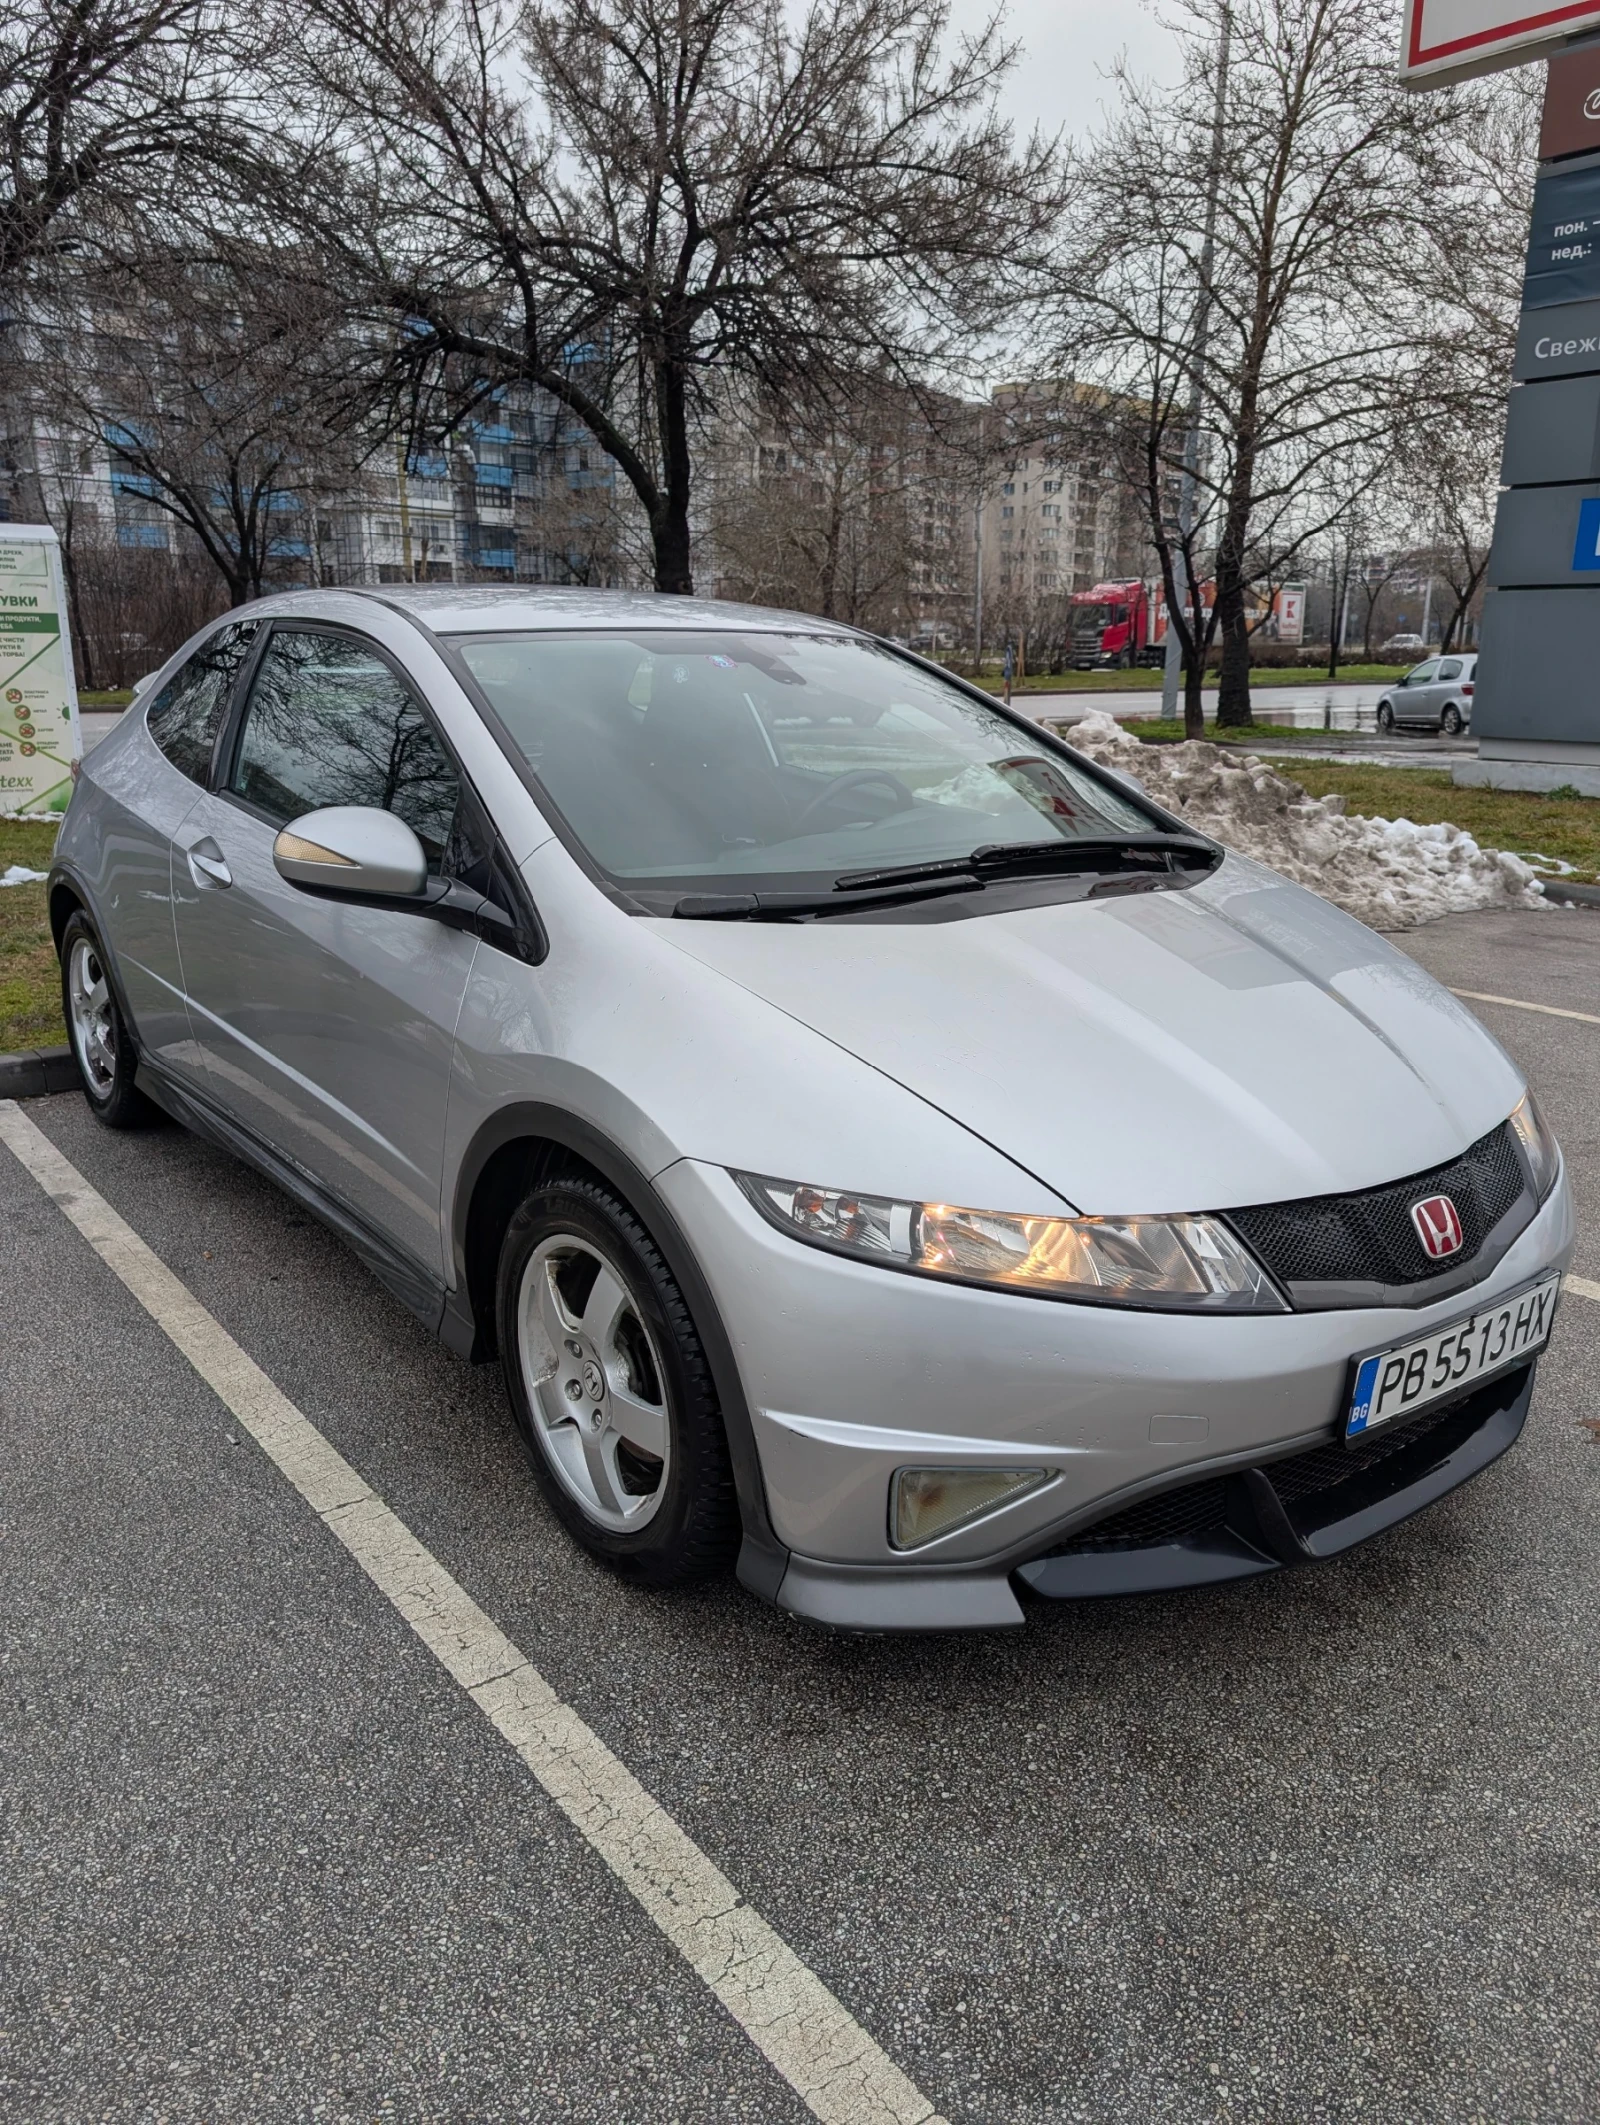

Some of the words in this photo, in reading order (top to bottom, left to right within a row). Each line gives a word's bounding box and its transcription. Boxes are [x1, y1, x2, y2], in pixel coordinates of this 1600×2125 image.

[1554, 221, 1588, 238] пон.
[1551, 243, 1592, 260] нед.:
[1351, 1403, 1369, 1423] BG
